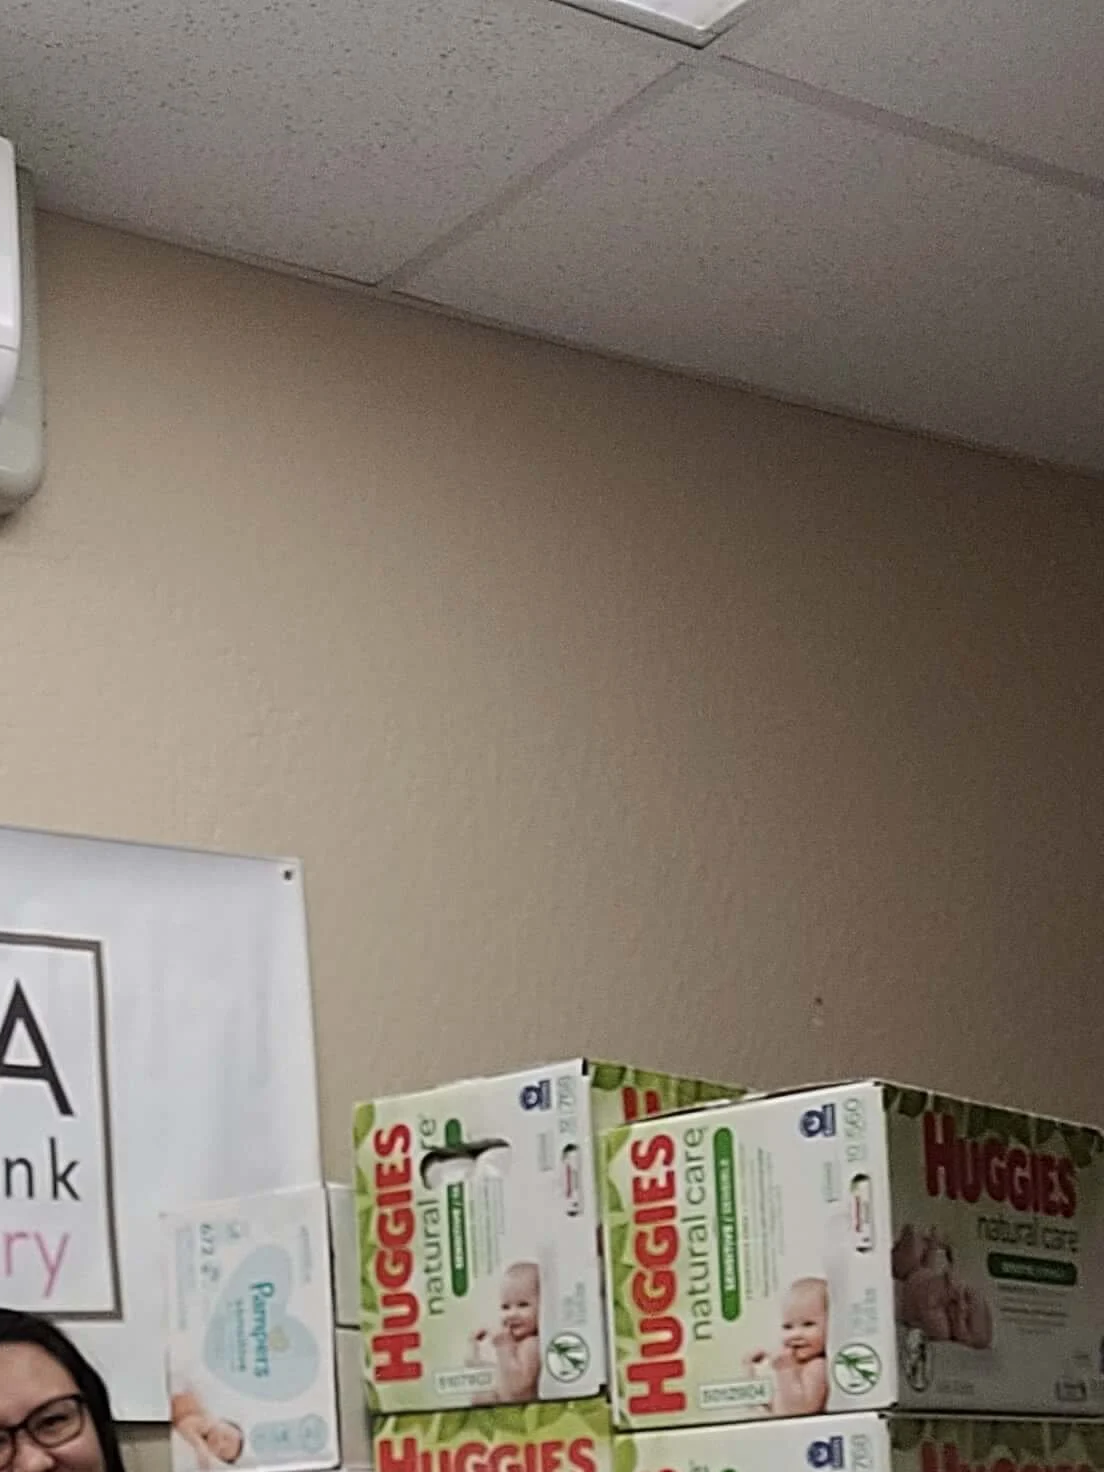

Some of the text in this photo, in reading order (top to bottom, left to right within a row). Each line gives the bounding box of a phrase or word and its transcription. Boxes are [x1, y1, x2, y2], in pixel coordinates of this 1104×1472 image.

[682, 1126, 714, 1343] natural care
[922, 1110, 1080, 1219] HUGGIES
[251, 1281, 276, 1378] Pampers
[370, 1123, 424, 1384] HUGGIES
[417, 1199, 446, 1317] natural
[625, 1132, 688, 1417] HUGGIES
